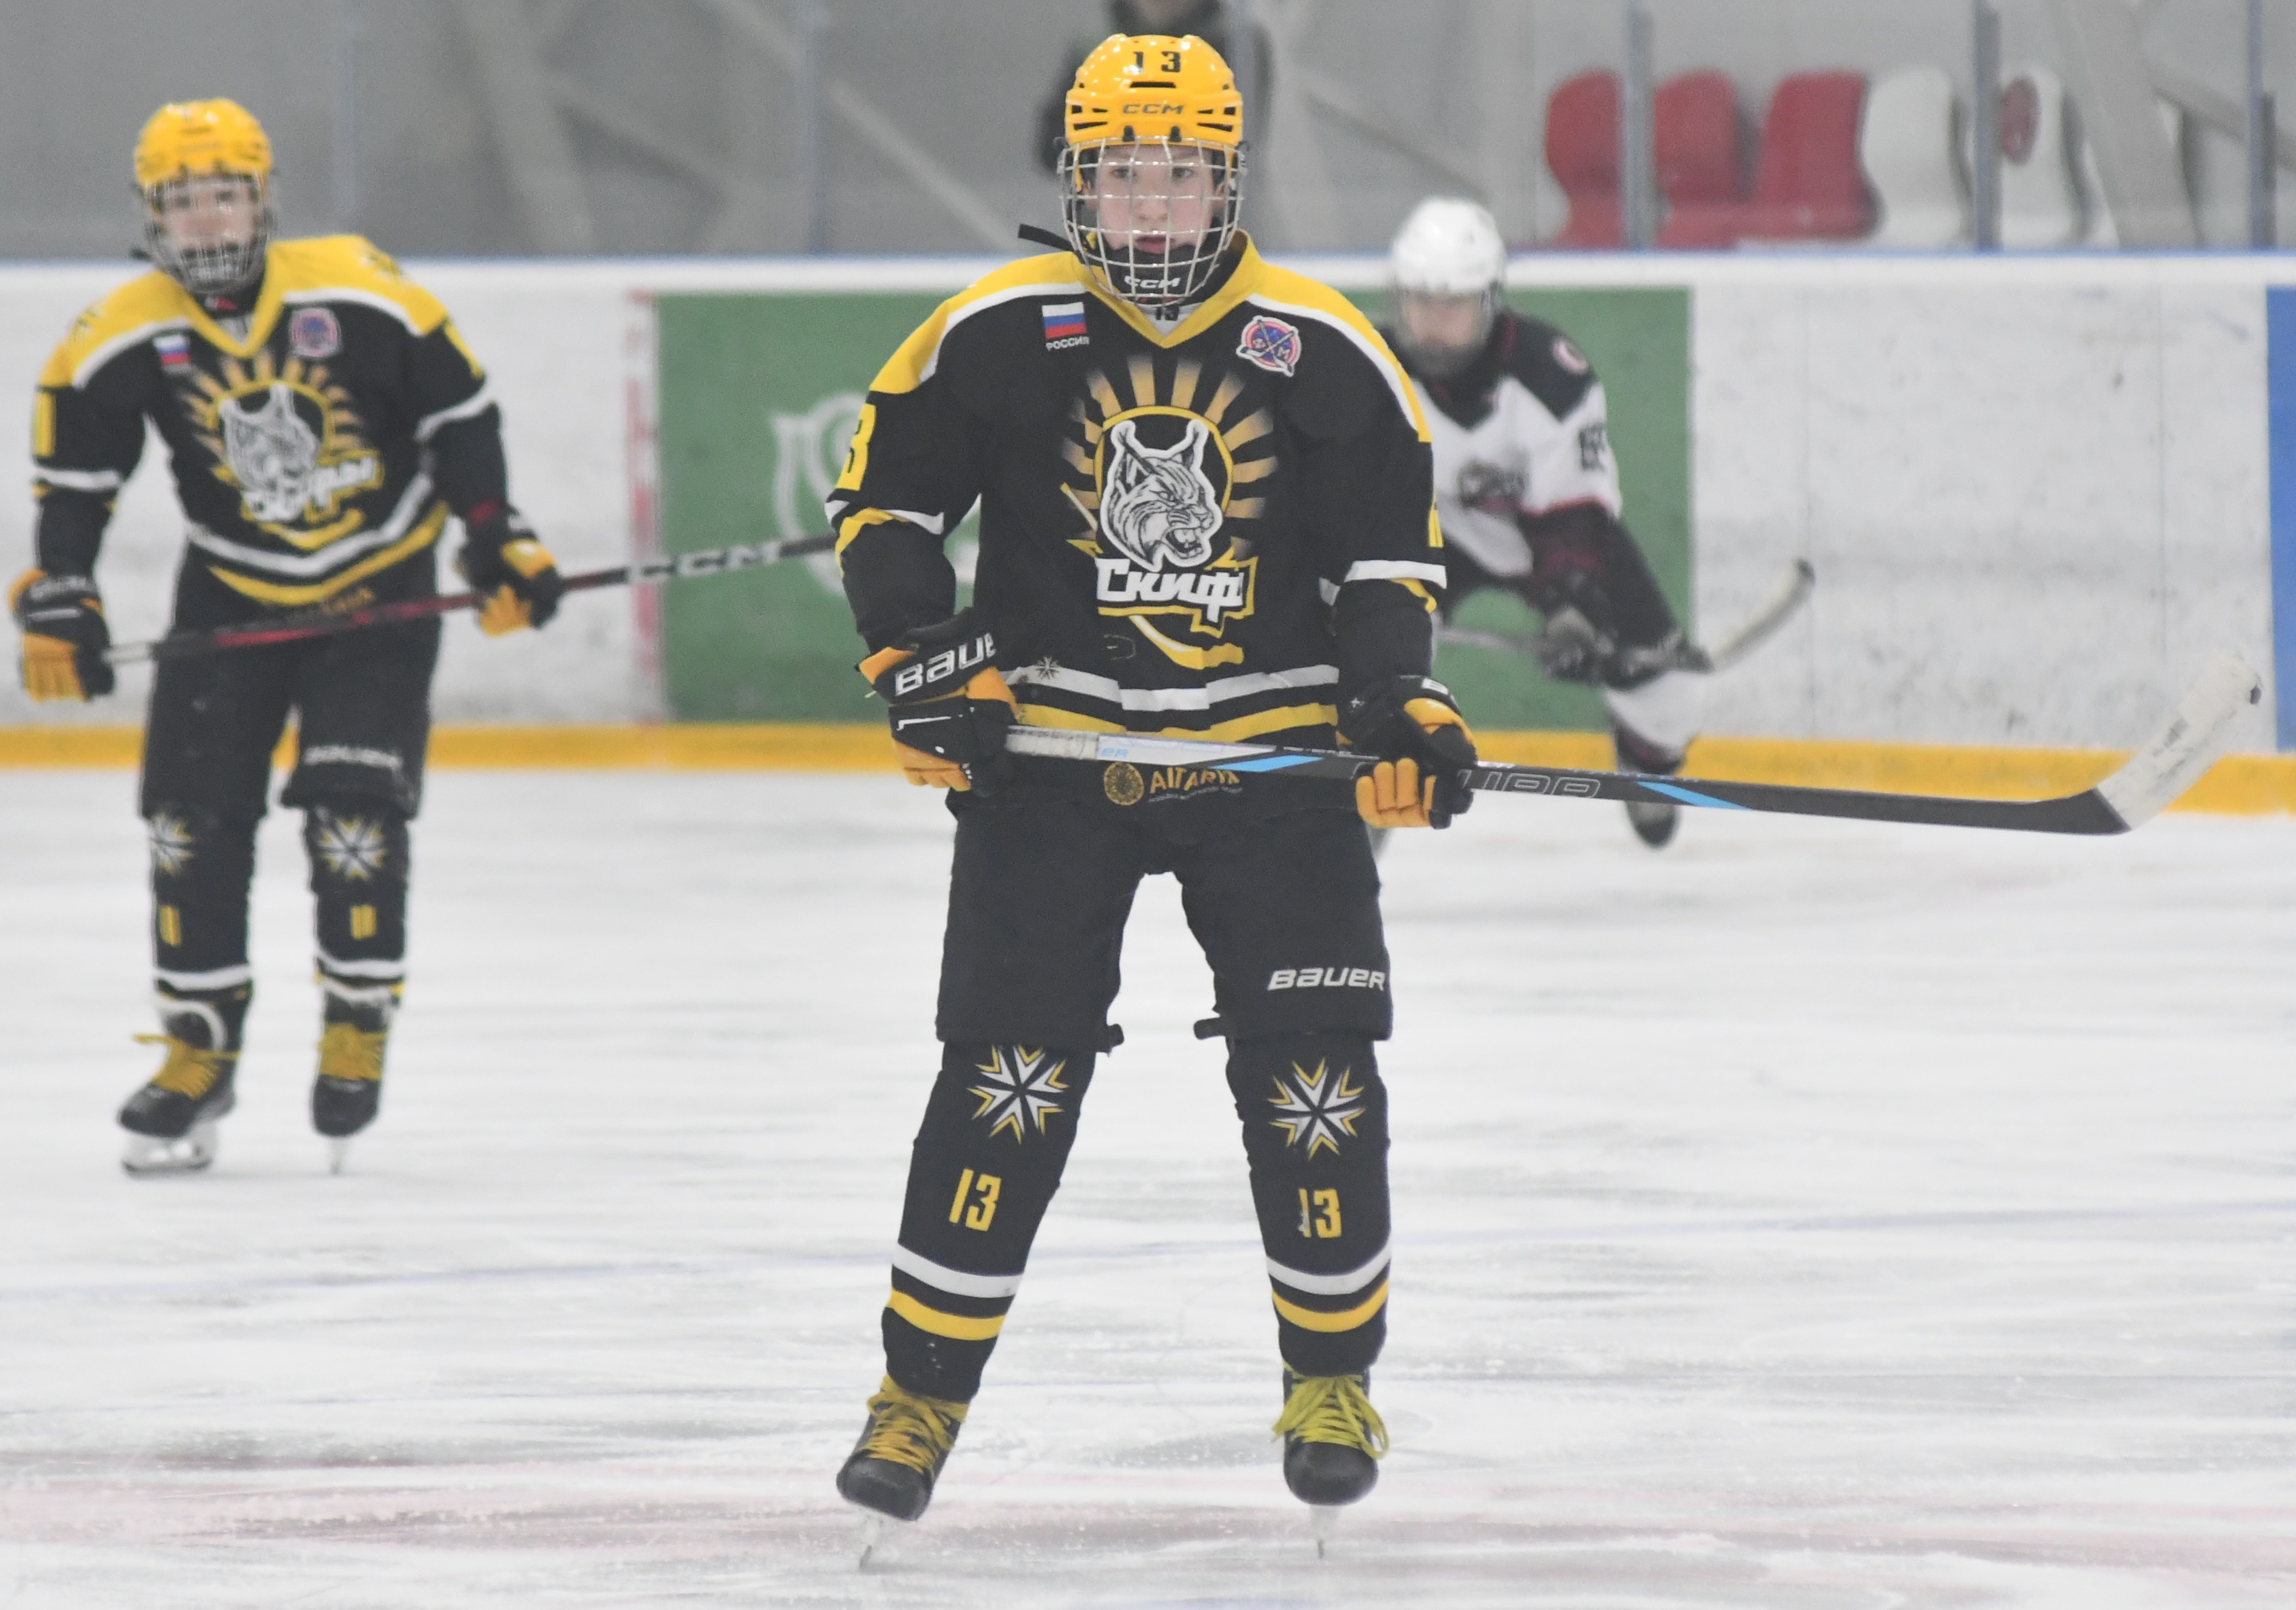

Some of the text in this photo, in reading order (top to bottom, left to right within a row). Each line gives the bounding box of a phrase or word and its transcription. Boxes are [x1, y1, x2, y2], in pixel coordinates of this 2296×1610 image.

[1123, 104, 1184, 114] CCM
[1124, 276, 1181, 288] CCM
[1046, 336, 1090, 351] РОССИЯ
[1095, 558, 1244, 623] Скиф
[895, 633, 996, 697] BAUE
[1267, 967, 1387, 991] BAUER
[949, 1168, 1002, 1232] 13
[1298, 1188, 1342, 1239] 13
